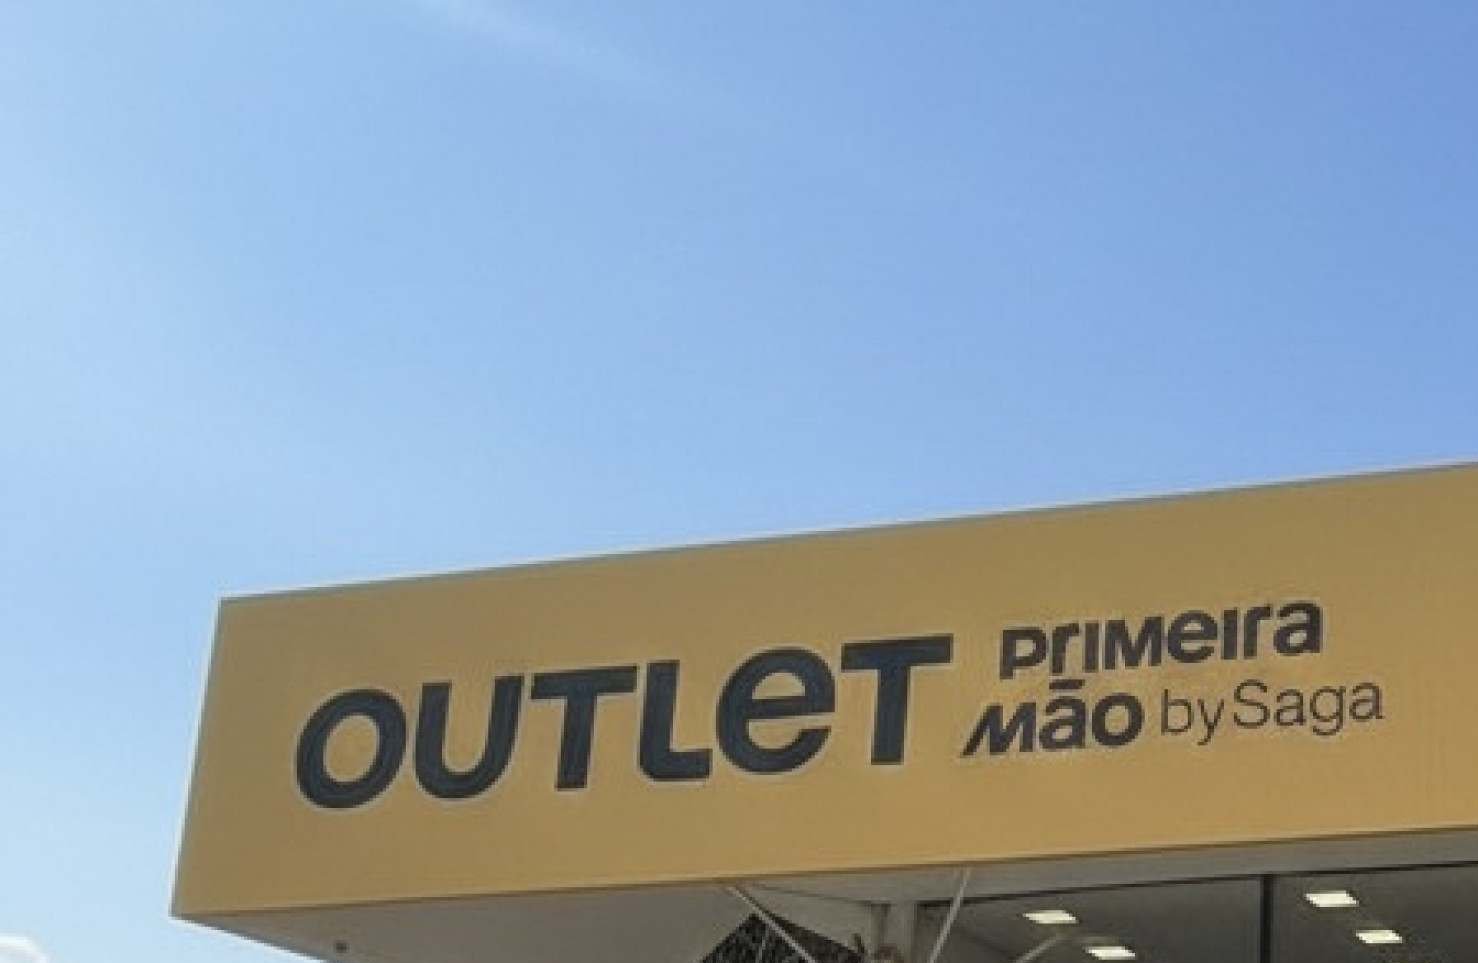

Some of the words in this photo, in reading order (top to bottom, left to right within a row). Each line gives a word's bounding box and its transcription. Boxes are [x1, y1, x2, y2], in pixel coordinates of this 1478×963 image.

[296, 635, 954, 809] OUTLeT
[962, 679, 1145, 757] Mão
[1160, 688, 1225, 746] by
[1232, 679, 1384, 736] Saga
